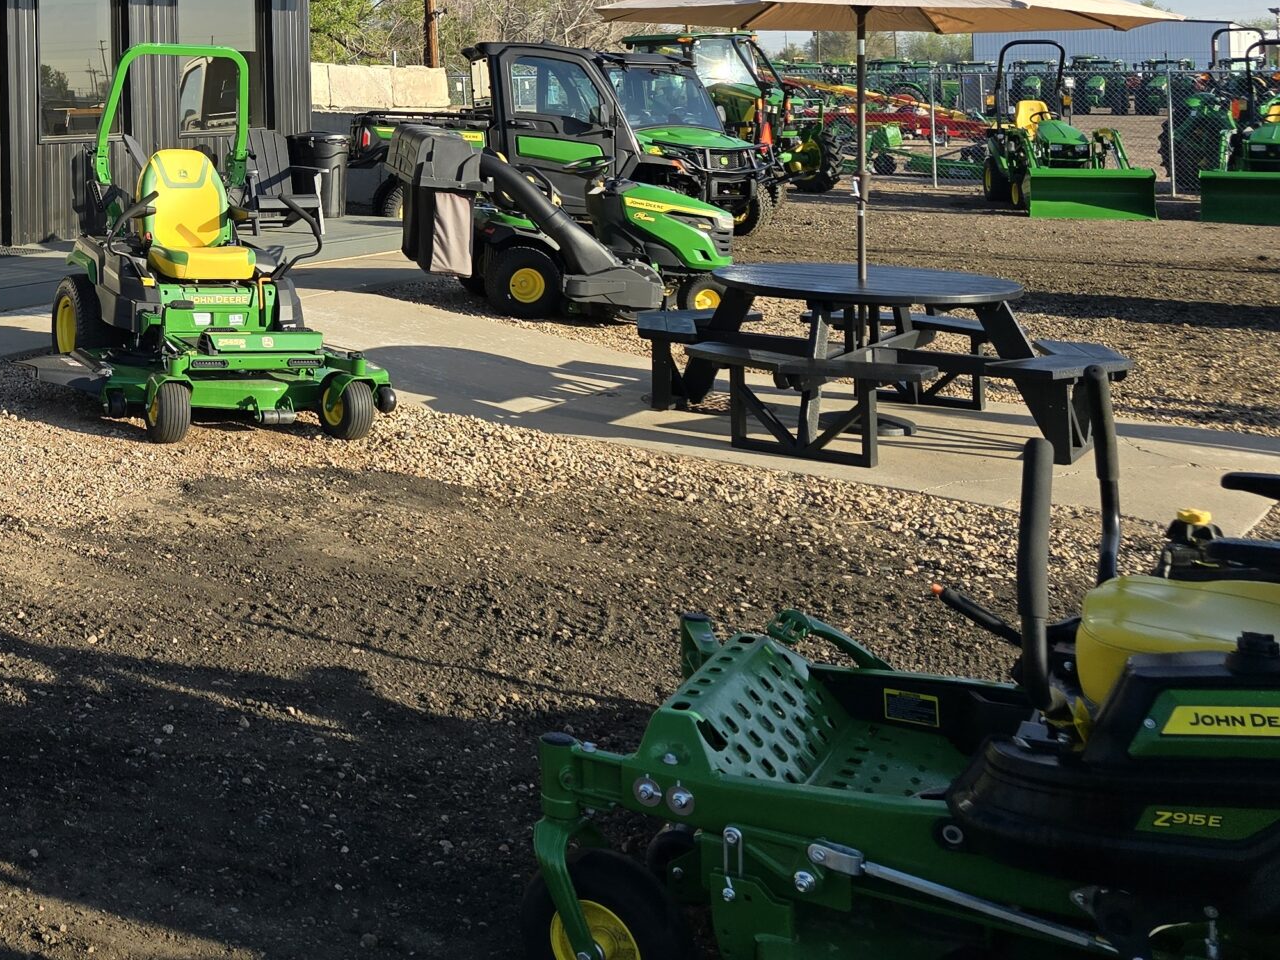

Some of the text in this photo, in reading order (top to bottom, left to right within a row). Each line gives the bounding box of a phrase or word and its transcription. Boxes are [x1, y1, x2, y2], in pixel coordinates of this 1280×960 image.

[645, 202, 664, 210] DEERE
[216, 295, 248, 305] DEERE
[1188, 712, 1246, 728] JOHN
[1153, 811, 1223, 827] Z915E
